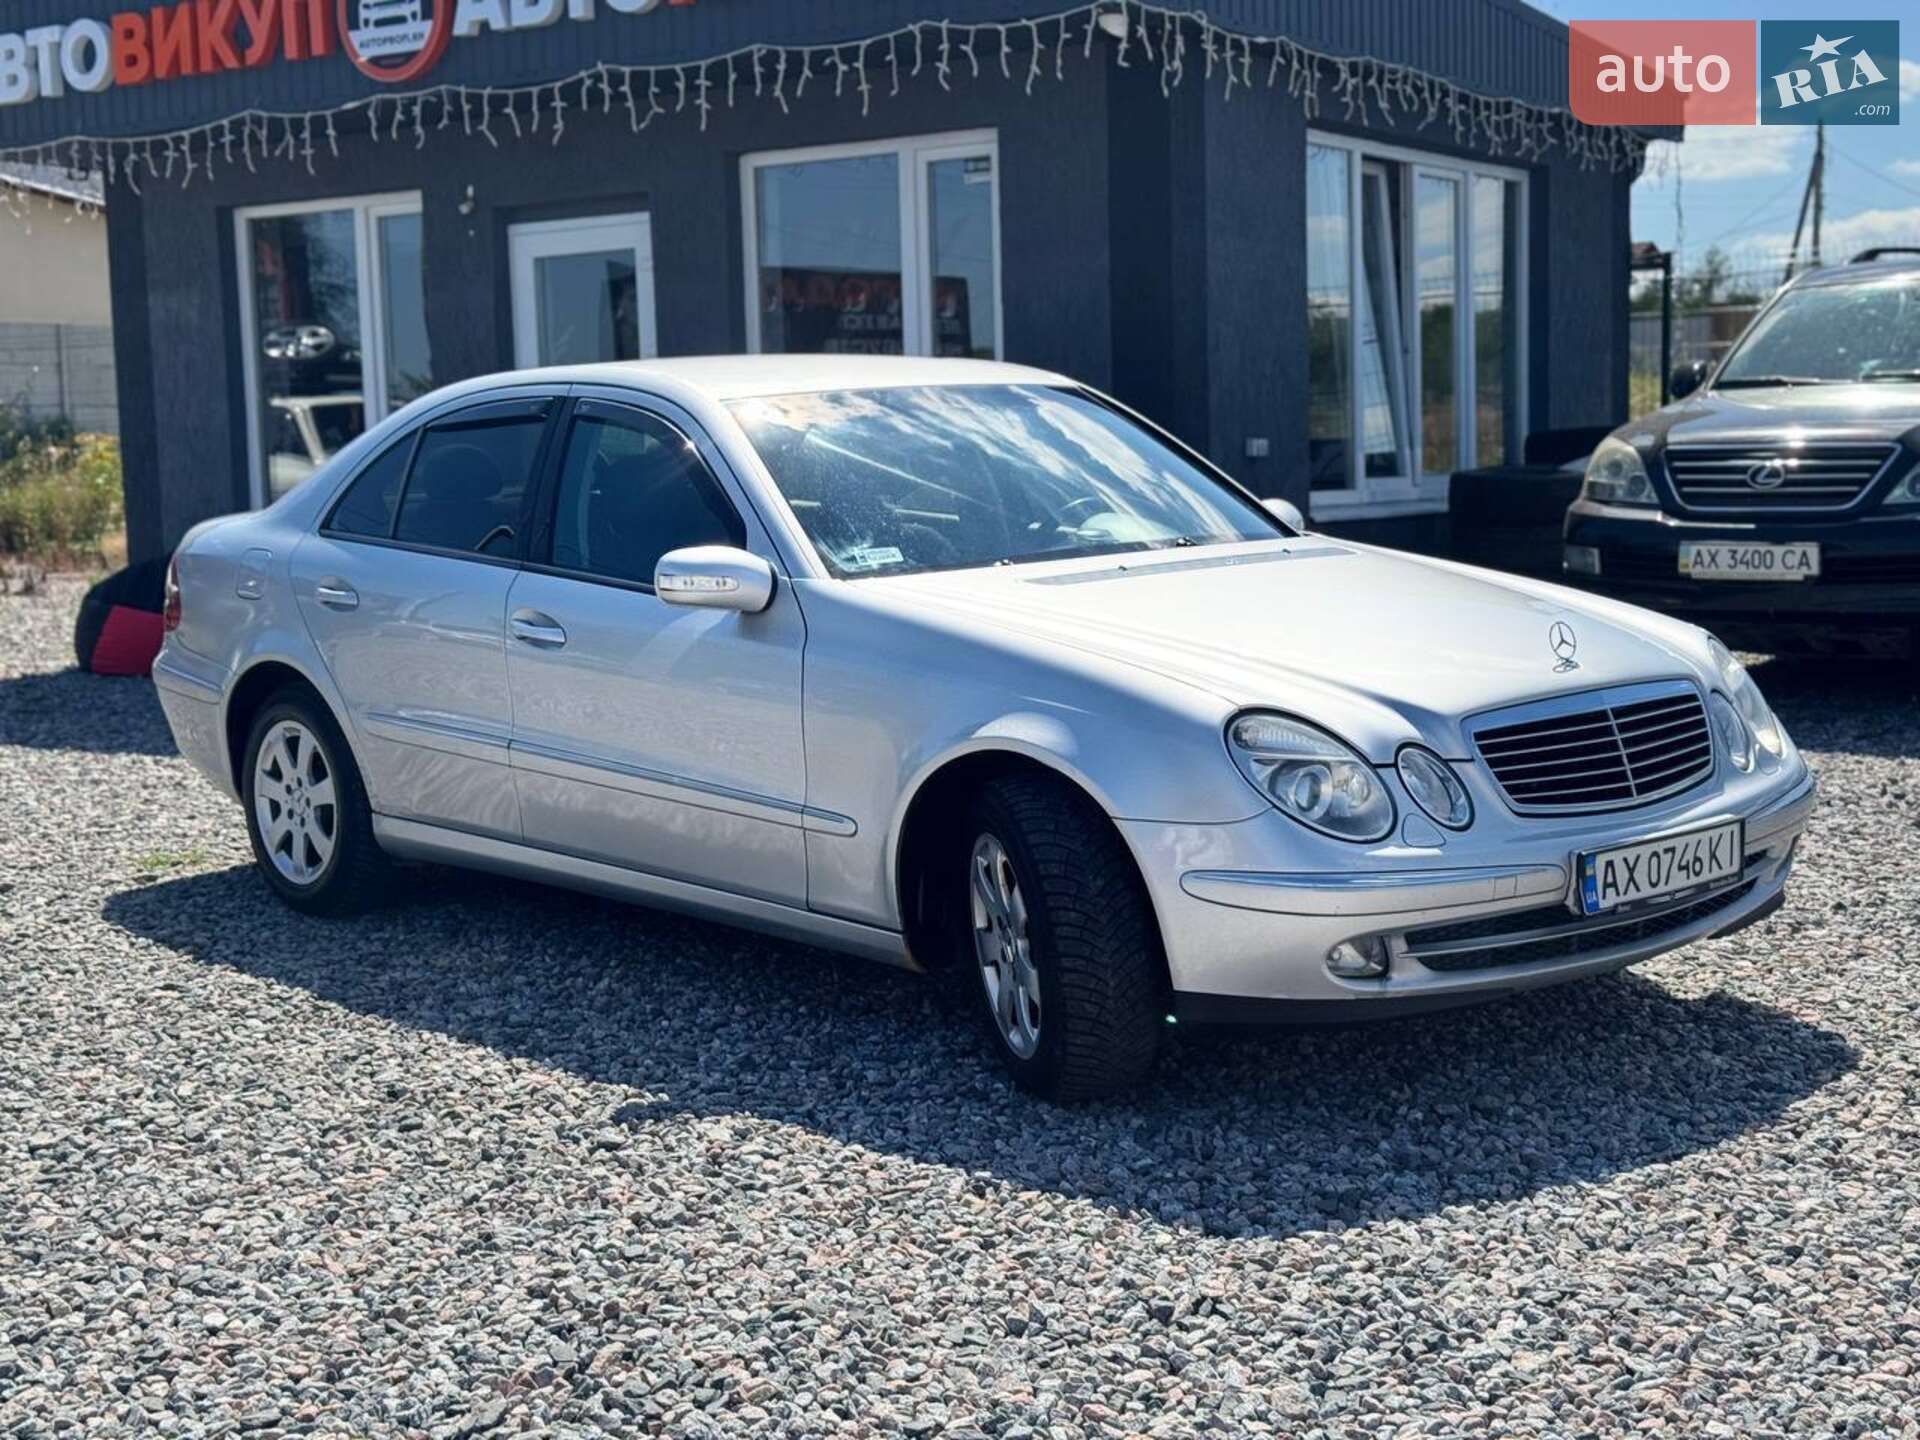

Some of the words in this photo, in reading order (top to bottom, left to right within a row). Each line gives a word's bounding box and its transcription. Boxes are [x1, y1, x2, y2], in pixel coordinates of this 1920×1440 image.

[1691, 549, 1719, 569] AX
[1727, 549, 1775, 570] 3400
[1781, 550, 1812, 571] CA
[1602, 854, 1641, 900] AX
[1648, 839, 1703, 889] 0746
[1709, 830, 1735, 873] KI
